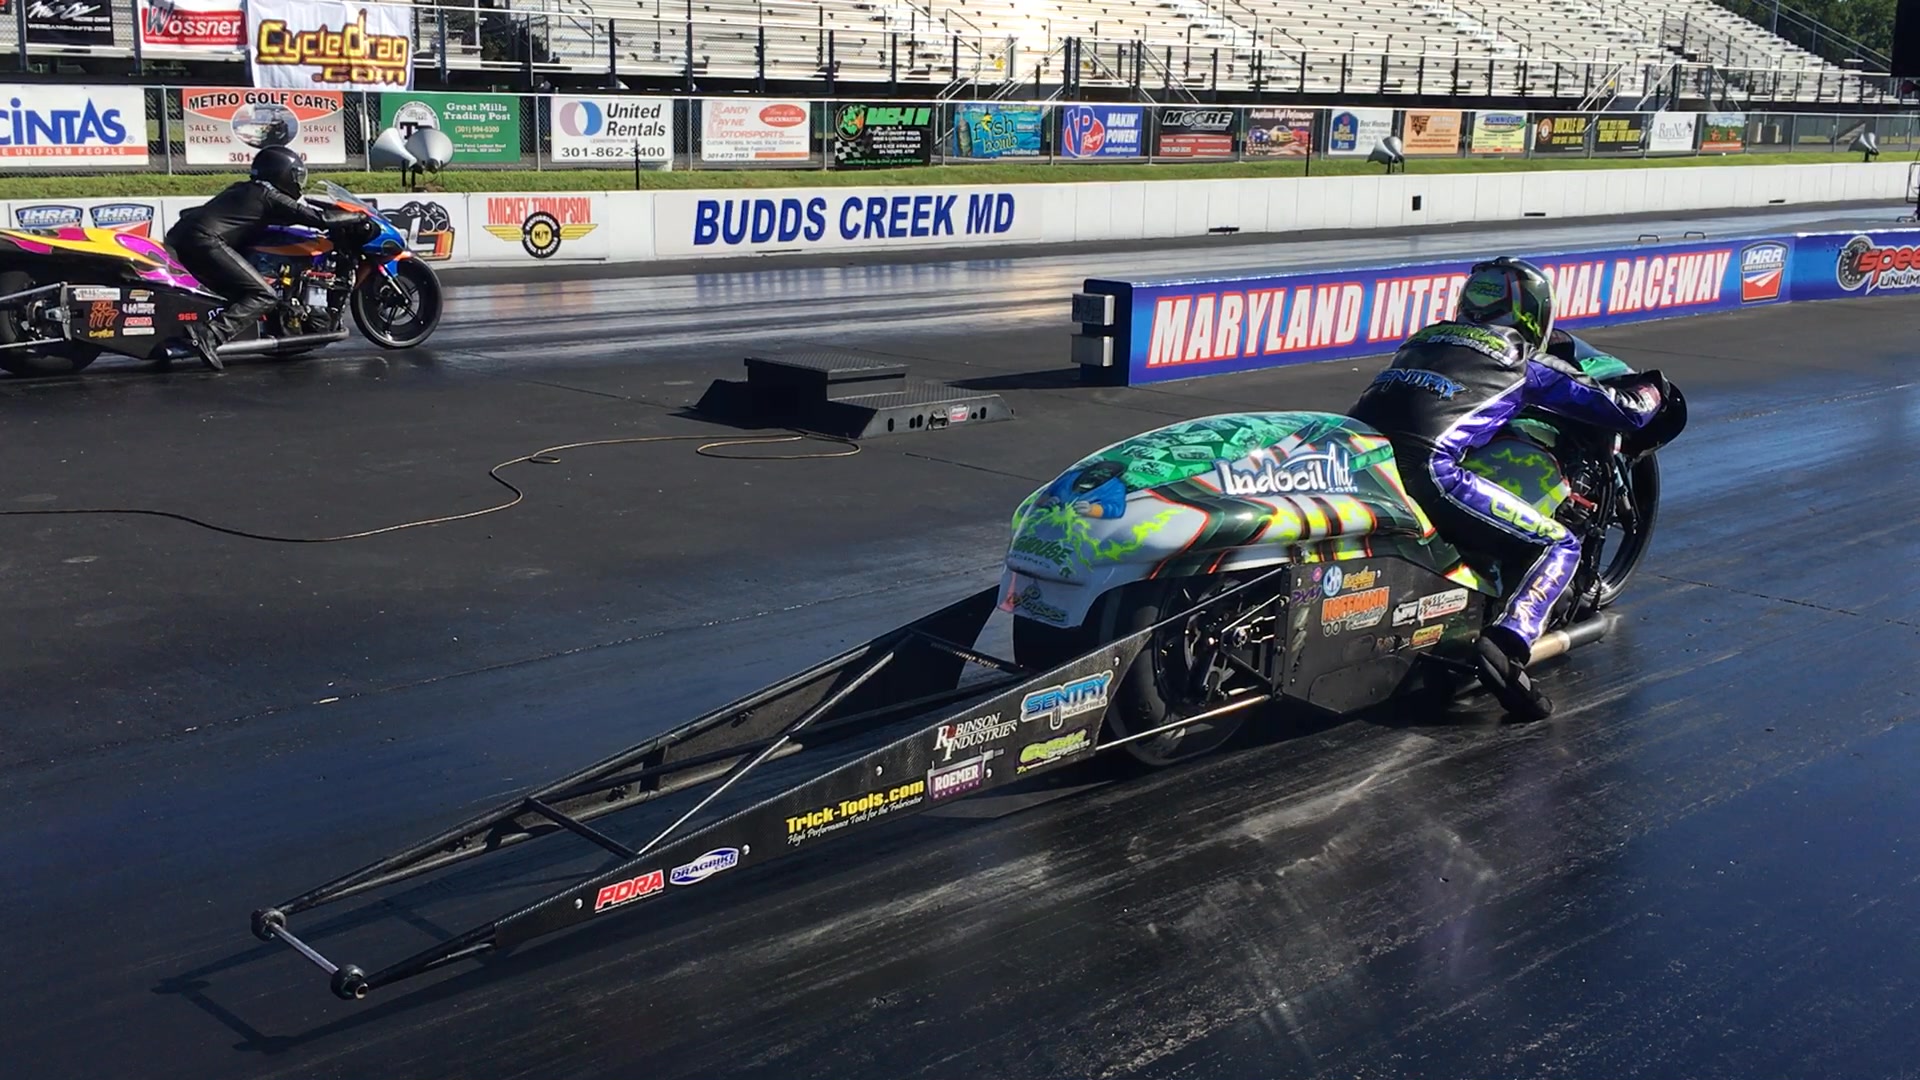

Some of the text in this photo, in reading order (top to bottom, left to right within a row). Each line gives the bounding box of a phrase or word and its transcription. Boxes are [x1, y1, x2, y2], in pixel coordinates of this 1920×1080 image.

[188, 92, 339, 112] METRO GOLF CARTS
[446, 102, 507, 112] Great Mills
[606, 103, 662, 119] United
[303, 125, 337, 133] SERVICE
[443, 112, 511, 122] Trading Post
[606, 121, 666, 137] Rentals
[1162, 110, 1234, 126] MOORE
[189, 136, 231, 144] RENTALS
[983, 133, 1019, 153] bomb
[1066, 105, 1096, 157] VP
[15, 147, 73, 156] UNIFORM
[78, 146, 126, 155] PEOPLE
[23, 210, 76, 220] IHRA
[97, 207, 149, 218] IHRA
[487, 196, 591, 225] MICKEY THOMPSON
[693, 193, 1015, 246] BUDDS CREEK MD
[1745, 248, 1783, 265] IHRA
[1147, 283, 1364, 367] MARYLAND
[1608, 249, 1732, 314] RACEWAY
[1221, 459, 1327, 496] Indocil
[1324, 484, 1359, 494] .com
[1323, 587, 1390, 623] HOFFMANN
[1025, 674, 1110, 715] SENTRY
[933, 712, 1001, 751] ROBINSON
[941, 721, 1018, 762] INDUSTRIES
[934, 764, 979, 792] ROEMER
[785, 780, 925, 834] Trick-Tools.com
[787, 795, 923, 847] High Performance Tools for the Fabricator
[671, 852, 736, 882] DRAGBIKE
[594, 868, 665, 911] PDRA
